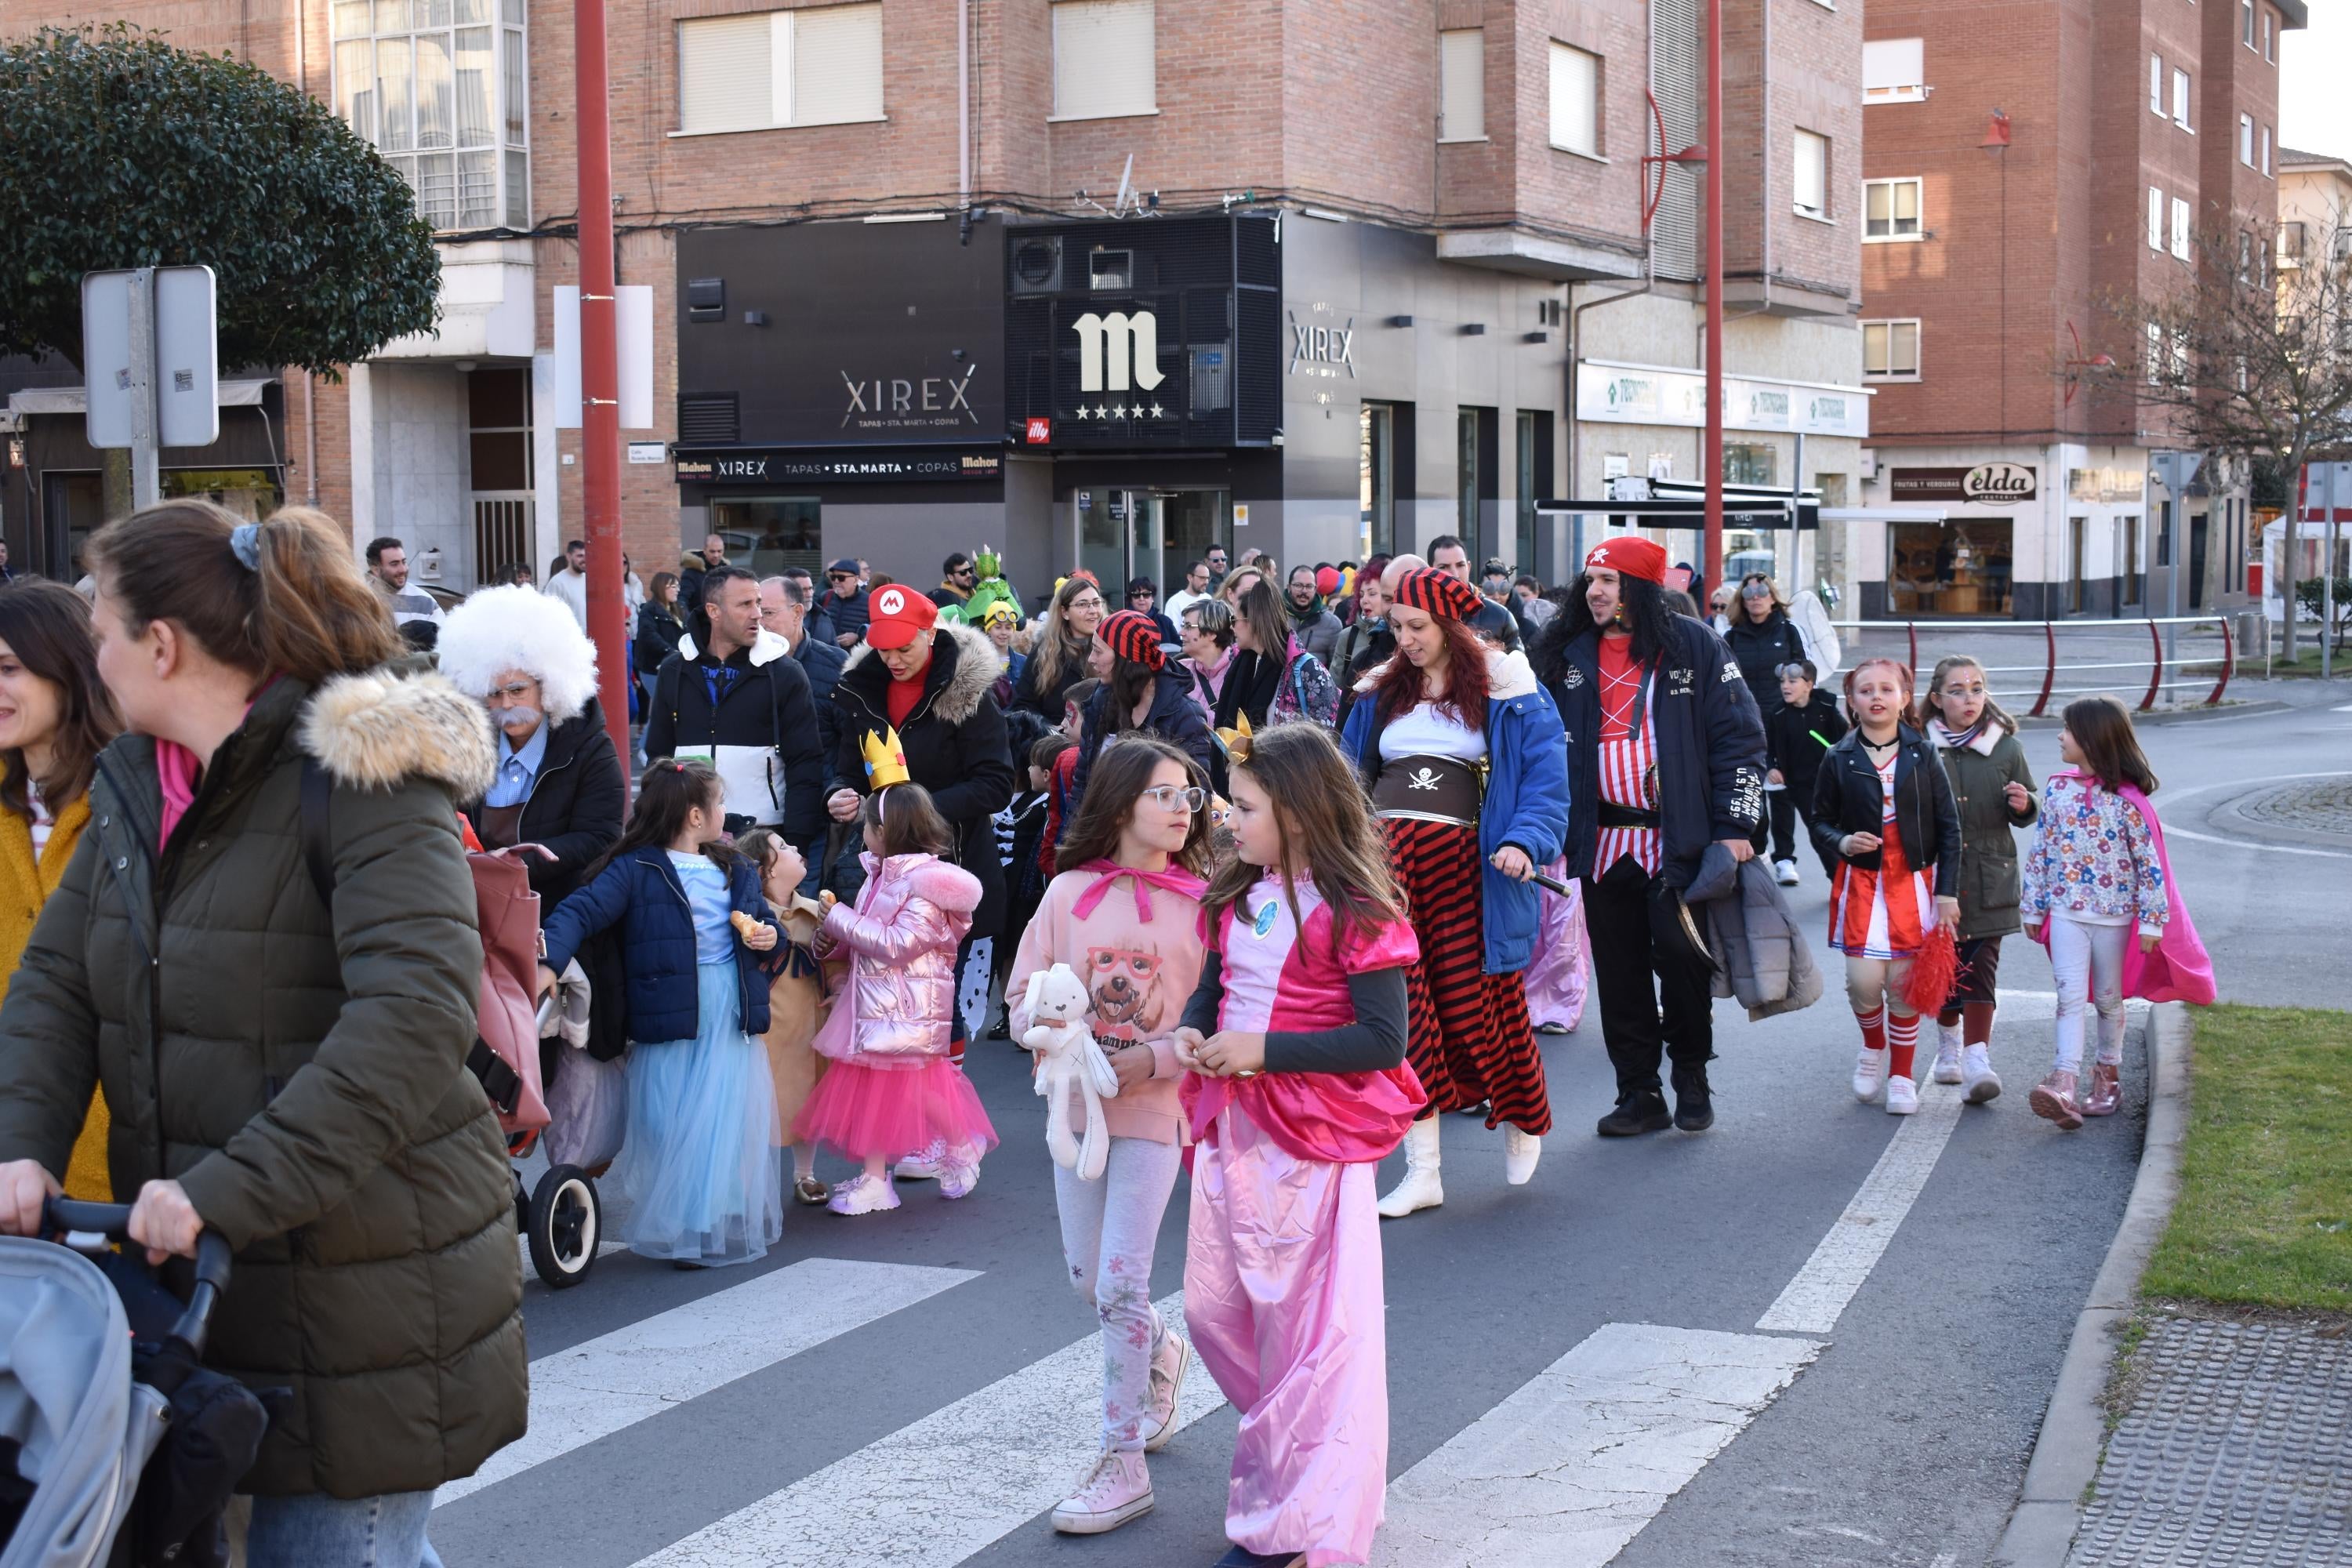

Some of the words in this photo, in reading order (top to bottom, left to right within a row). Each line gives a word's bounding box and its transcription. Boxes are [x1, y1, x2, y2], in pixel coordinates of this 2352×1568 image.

[1029, 423, 1049, 440] illy
[677, 463, 712, 472] Mahou
[962, 456, 998, 468] Mahou
[786, 465, 821, 474] TAPAS
[861, 463, 902, 473] MARTA
[917, 463, 957, 472] COPAS
[1971, 467, 2027, 492] elda
[884, 597, 899, 608] M
[1730, 797, 1743, 818] 1999
